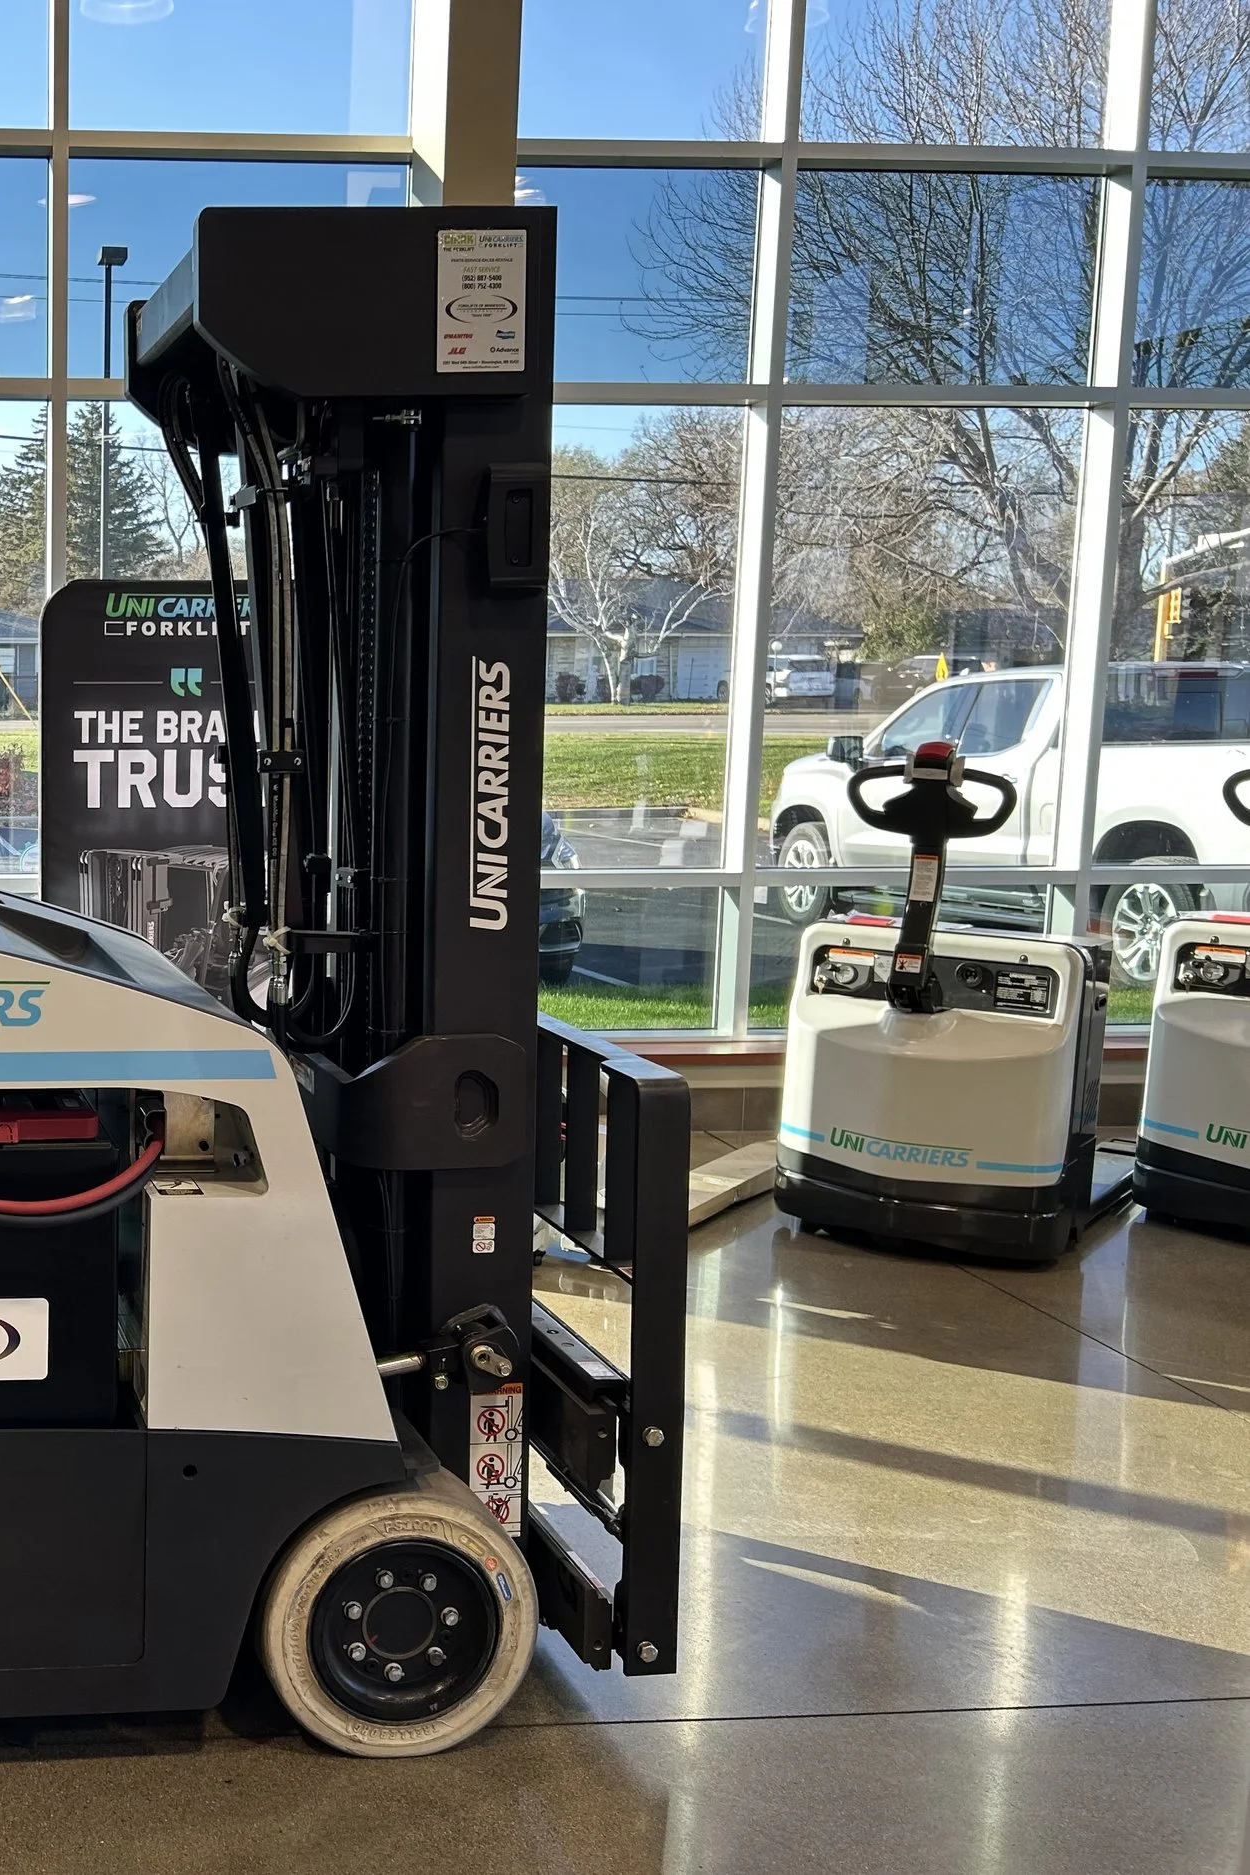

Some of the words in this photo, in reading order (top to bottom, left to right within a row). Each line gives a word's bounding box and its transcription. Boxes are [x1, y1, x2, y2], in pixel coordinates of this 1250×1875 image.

[126, 621, 250, 636] FORKLIT
[73, 711, 143, 743] THE
[469, 656, 510, 931] UNICARRIERS
[830, 1127, 972, 1168] UNICARRIERS
